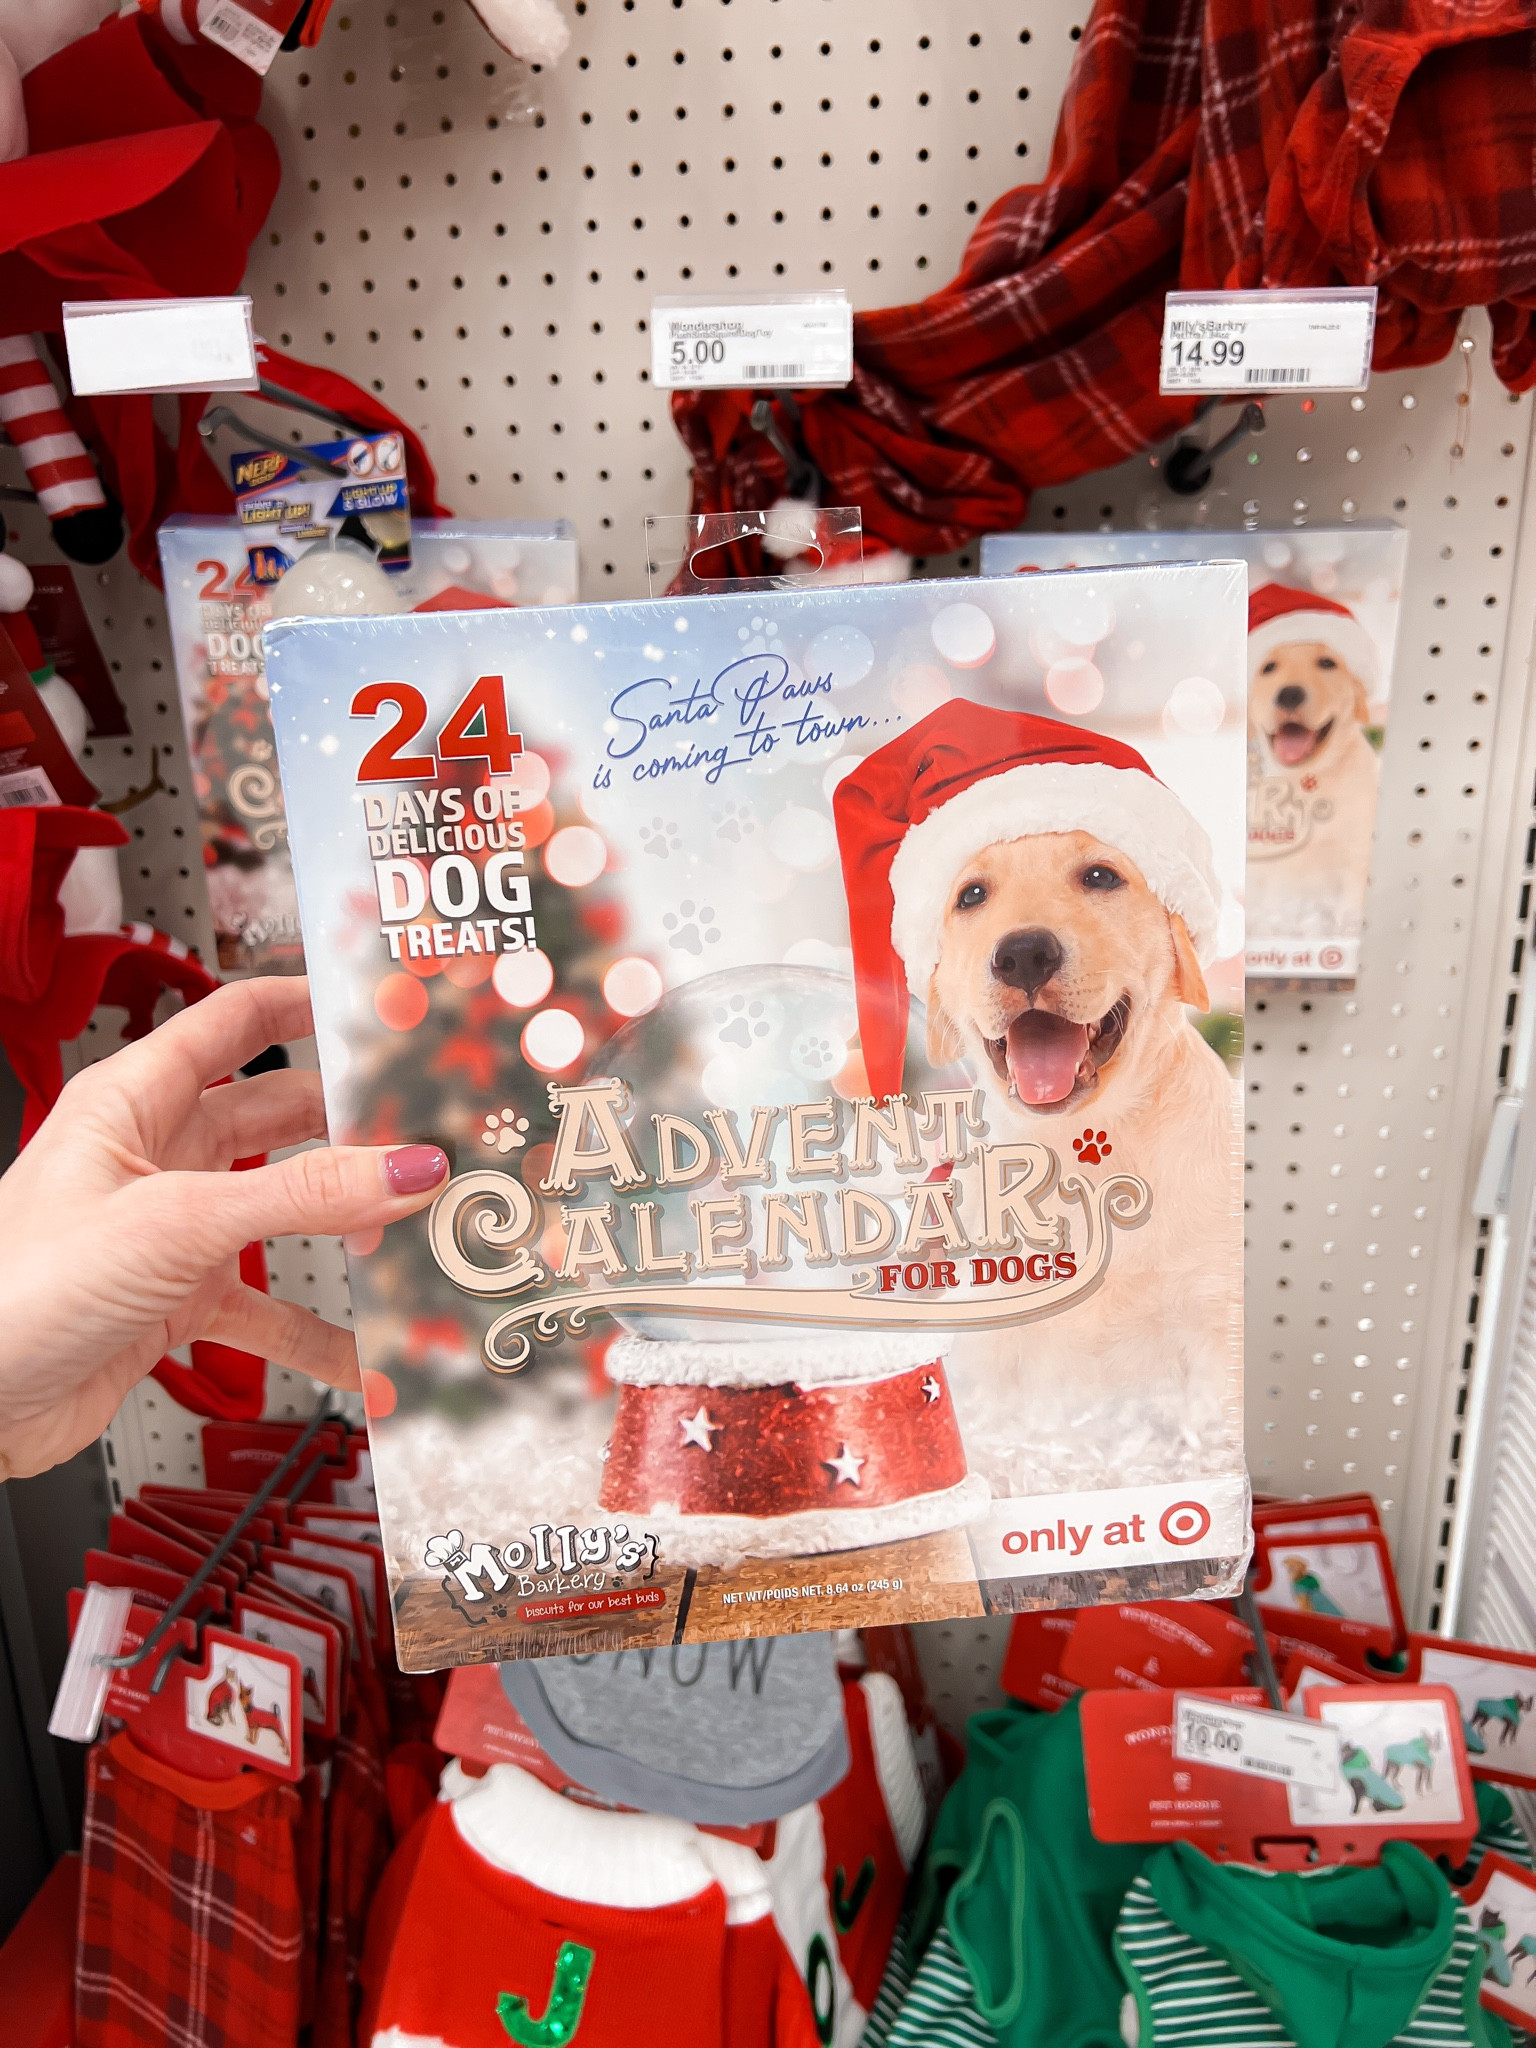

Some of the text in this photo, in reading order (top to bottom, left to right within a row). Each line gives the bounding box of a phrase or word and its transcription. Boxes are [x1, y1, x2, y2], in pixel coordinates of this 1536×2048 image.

[671, 340, 724, 364] 5.00
[1171, 341, 1244, 366] 14.99
[236, 455, 285, 485] NERF
[607, 653, 832, 759] Santa Paws
[349, 674, 525, 783] 24
[593, 701, 903, 789] is coming to town...
[363, 784, 522, 830] DAYS OF
[367, 821, 527, 859] DELICIOUS
[374, 851, 533, 924] DOG
[380, 916, 538, 961] TREATS!
[540, 1077, 986, 1196] ADVENT
[428, 1142, 1072, 1297] CALENDAR
[877, 1252, 1079, 1294] FOR DOGS
[1001, 1514, 1145, 1556] only at
[451, 1524, 648, 1601] Molly's
[517, 1571, 607, 1597] Barkery
[525, 1592, 660, 1617] biscuits for our best buds
[723, 1578, 903, 1604] NET WT/POIDS NET. 8.64 oz (245 g)
[1184, 1724, 1243, 1752] 10.00
[498, 1940, 595, 2048] J
